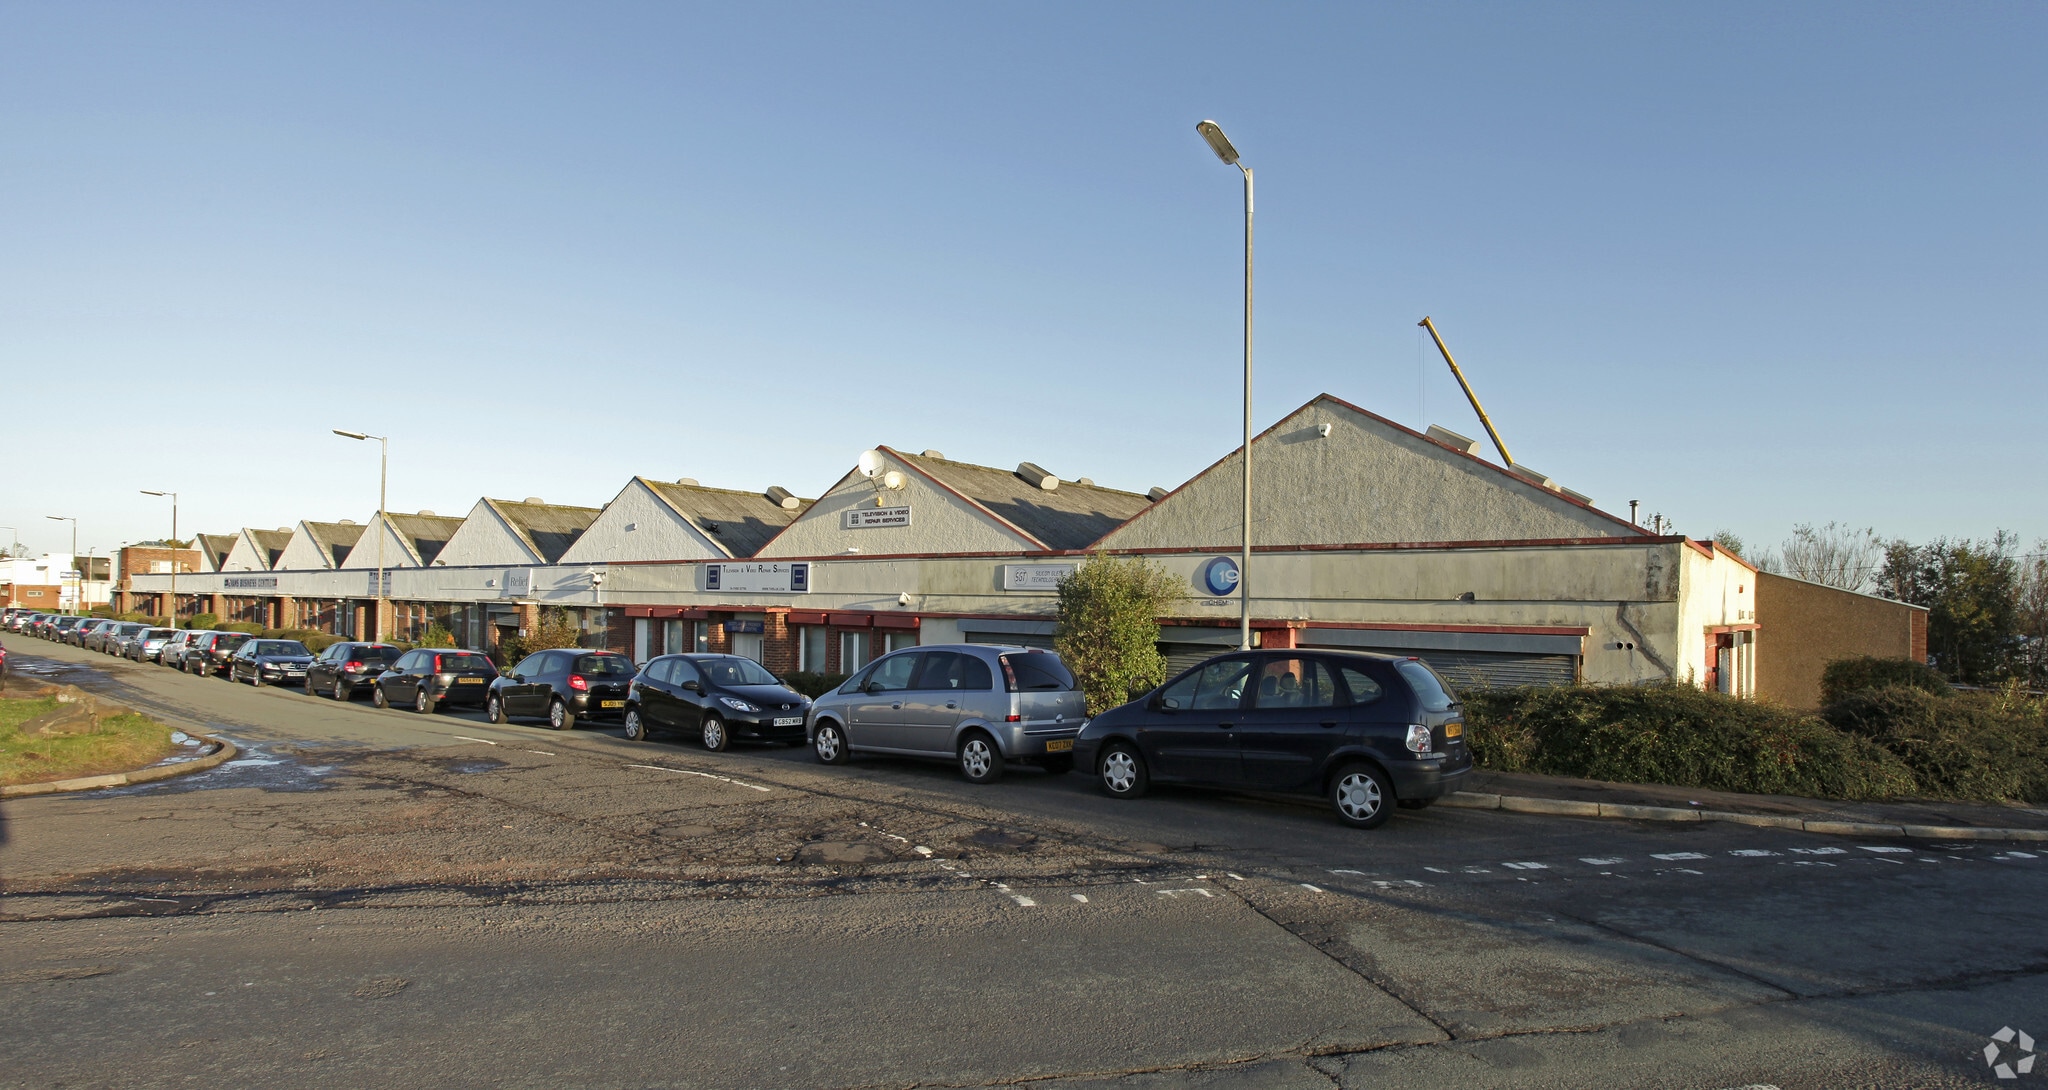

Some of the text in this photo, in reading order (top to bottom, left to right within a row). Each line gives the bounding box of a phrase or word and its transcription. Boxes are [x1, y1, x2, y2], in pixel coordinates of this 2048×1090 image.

[861, 510, 888, 518] TELEVISION
[882, 516, 906, 524] SERVICES
[240, 578, 257, 587] BUSINESS
[510, 576, 528, 587] Relief
